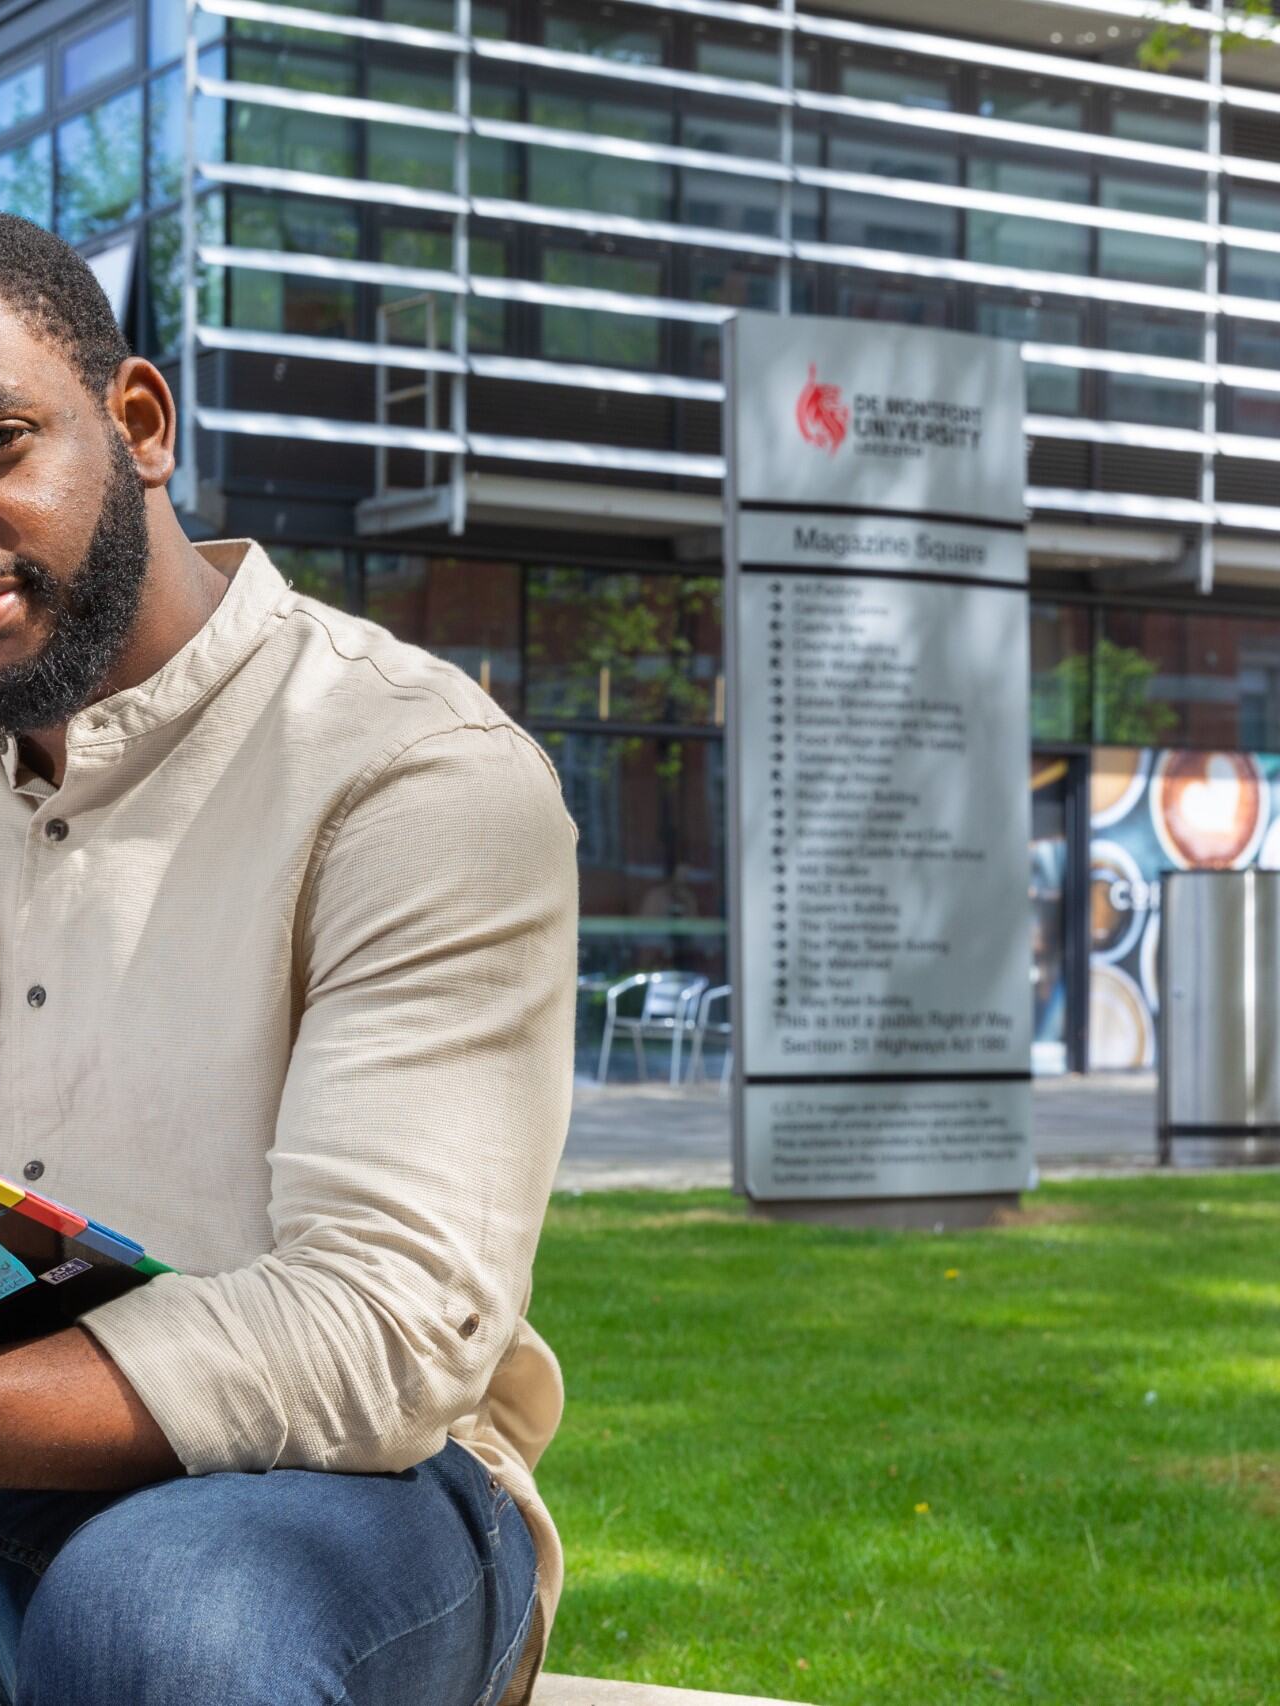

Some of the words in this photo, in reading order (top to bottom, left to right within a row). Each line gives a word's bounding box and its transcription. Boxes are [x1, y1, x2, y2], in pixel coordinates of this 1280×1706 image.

[856, 396, 879, 412] DE
[887, 398, 981, 425] MONTFORT
[856, 419, 981, 450] UNIVERSITY
[794, 528, 908, 557] Magazine
[916, 535, 985, 564] Square
[774, 1013, 808, 1028] This
[815, 1013, 828, 1028] is
[833, 1014, 859, 1028] not
[865, 1016, 873, 1028] a
[880, 1014, 924, 1030] public
[930, 1012, 965, 1032] Right
[969, 1012, 981, 1026] of
[984, 1012, 1011, 1031] Way
[783, 1038, 844, 1054] Section
[875, 1038, 946, 1055] Highways
